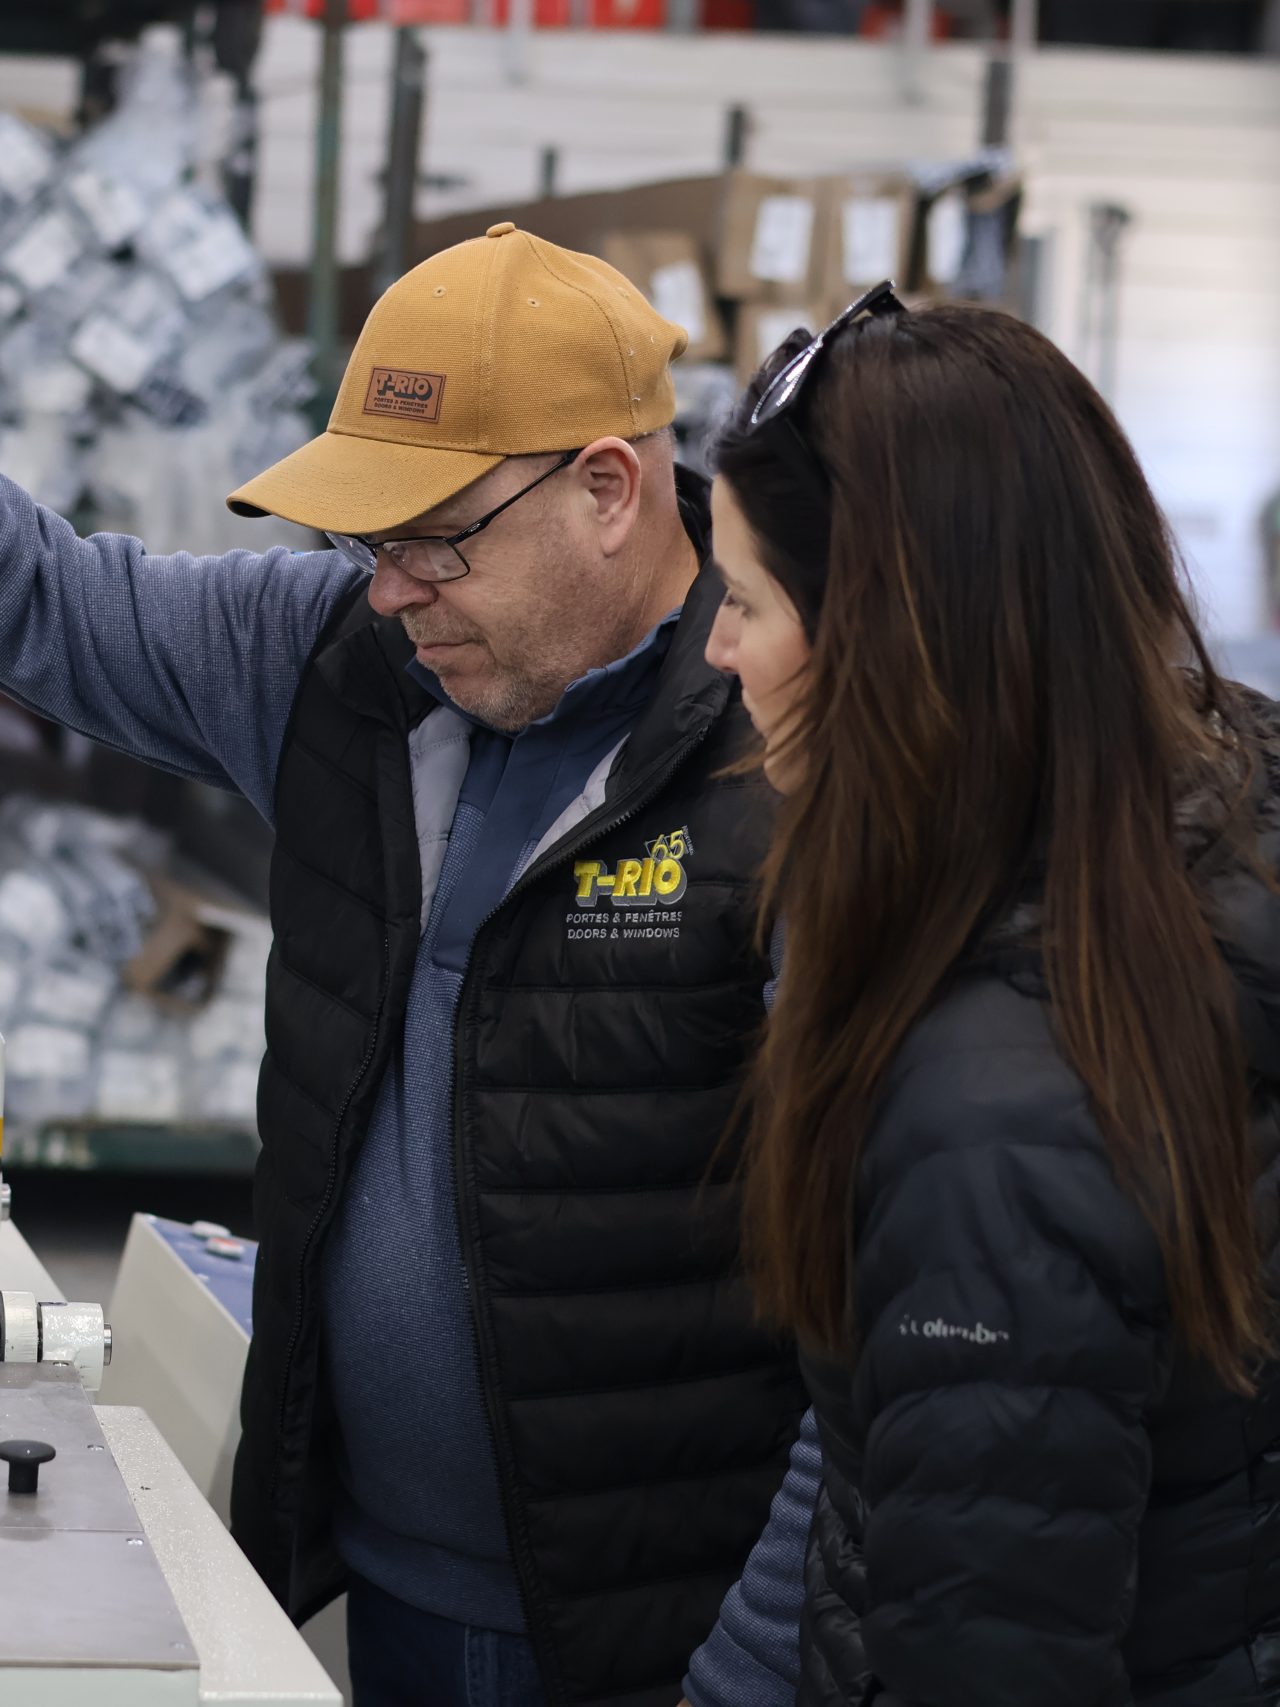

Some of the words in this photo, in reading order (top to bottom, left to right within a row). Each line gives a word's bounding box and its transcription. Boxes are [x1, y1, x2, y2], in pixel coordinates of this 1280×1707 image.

[377, 373, 432, 401] T-RIO
[398, 406, 425, 415] WINDOWS
[651, 830, 685, 861] 65
[574, 858, 686, 906] T-RIO
[566, 913, 609, 924] PORTES
[613, 912, 621, 923] &
[625, 909, 683, 923] FENÊTRES
[567, 928, 607, 939] DOORS
[610, 928, 619, 939] &
[623, 927, 680, 938] WINDOWS
